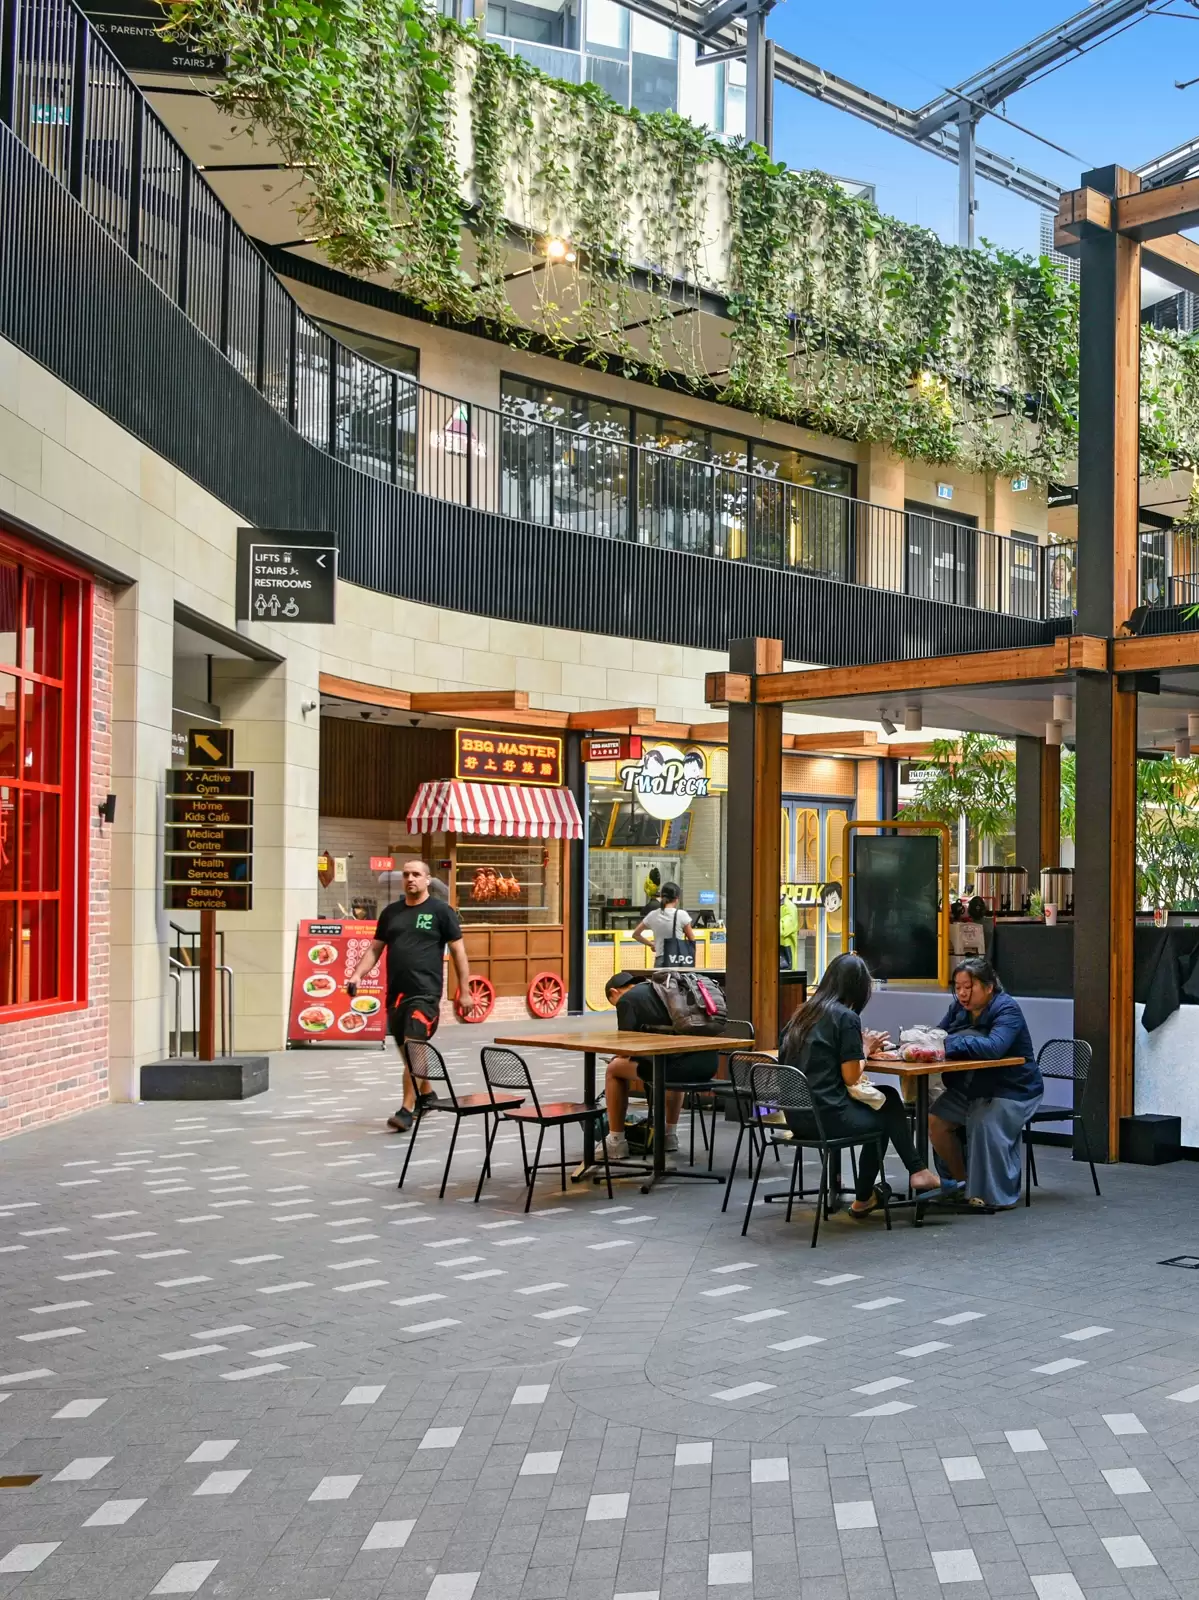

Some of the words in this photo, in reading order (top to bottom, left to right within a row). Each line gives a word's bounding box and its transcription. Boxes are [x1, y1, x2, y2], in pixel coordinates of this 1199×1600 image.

[110, 25, 155, 37] PARENTS
[172, 56, 205, 68] STAIRS
[255, 553, 280, 562] LIFTS
[255, 566, 288, 575] STAIRS
[254, 578, 312, 589] RESTROOMS
[461, 739, 494, 753] BBQ
[497, 742, 556, 758] MASTER
[185, 773, 193, 782] X
[201, 773, 231, 782] Active
[196, 784, 220, 795] Gym
[192, 802, 223, 811] Ho'me
[185, 812, 205, 821] Kids
[207, 812, 230, 822] Café
[186, 829, 224, 839] Medical
[188, 840, 221, 850] Centre
[192, 858, 224, 868] Health
[187, 869, 229, 879] Services
[190, 888, 223, 898] Beauty
[187, 898, 227, 908] Services
